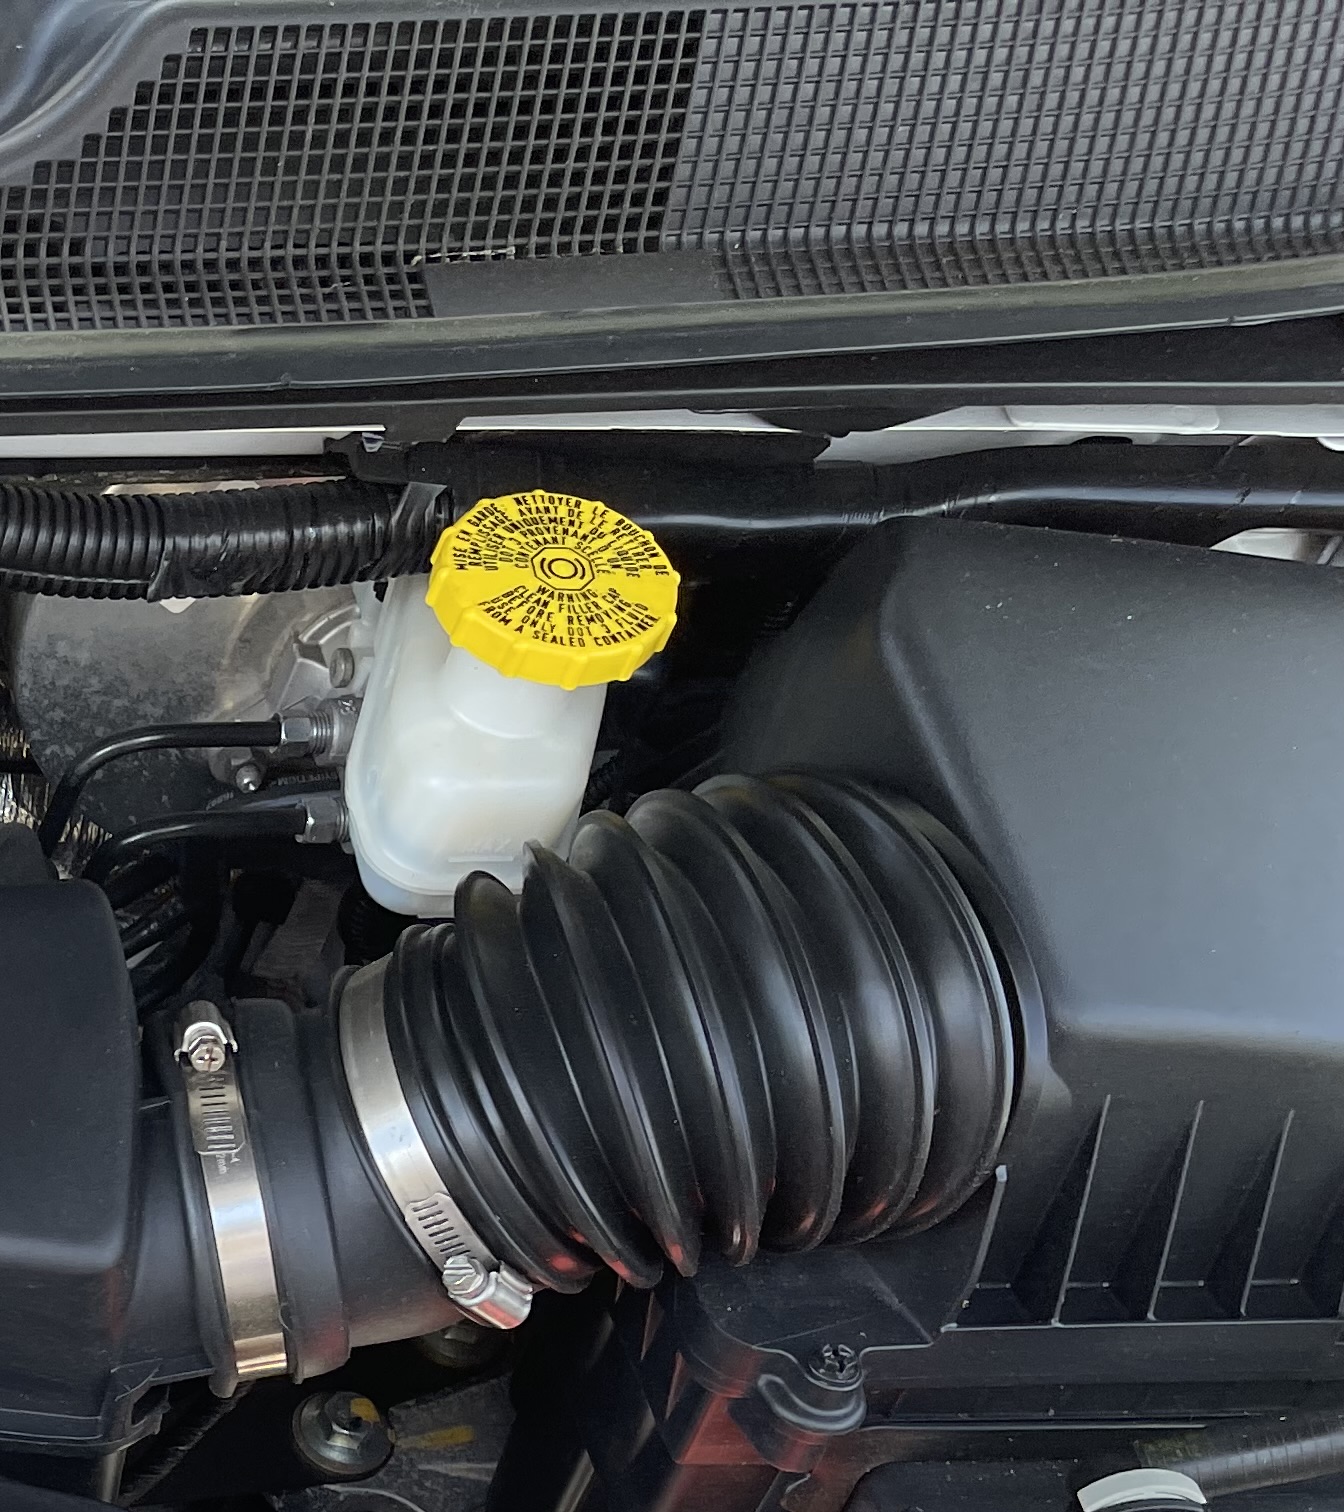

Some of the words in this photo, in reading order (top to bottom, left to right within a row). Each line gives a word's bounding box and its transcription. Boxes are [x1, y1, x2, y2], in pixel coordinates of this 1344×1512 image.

[513, 494, 582, 509] NETTOYER
[593, 506, 609, 519] LE
[456, 529, 472, 542] EN
[467, 510, 512, 566] REMPLISSAGE
[517, 505, 559, 517] AVANT
[567, 508, 584, 520] DE
[590, 515, 608, 529] LE
[610, 528, 653, 569] RETIRER
[482, 533, 507, 571] UTILISER
[502, 515, 584, 534] UNIQUEMENT
[589, 527, 607, 540] DU
[499, 545, 517, 563] DOT
[519, 526, 597, 545] PROVENANT
[514, 536, 566, 569] CONTENANT
[615, 518, 660, 558] BOUCHON
[452, 546, 468, 570] MISE
[501, 590, 555, 622] BEFORE
[567, 599, 632, 625] REMOVING
[513, 585, 551, 609] CLEAN
[558, 600, 602, 614] FILLER
[601, 587, 621, 605] CAP
[536, 585, 599, 603] WARNING
[477, 601, 513, 625] FROM
[514, 625, 525, 634] A
[532, 630, 585, 647] SEALED
[491, 596, 516, 615] USE
[521, 615, 556, 633] ONLY
[567, 626, 593, 637] DOT
[601, 624, 611, 634] 3
[614, 603, 649, 629] FLUID
